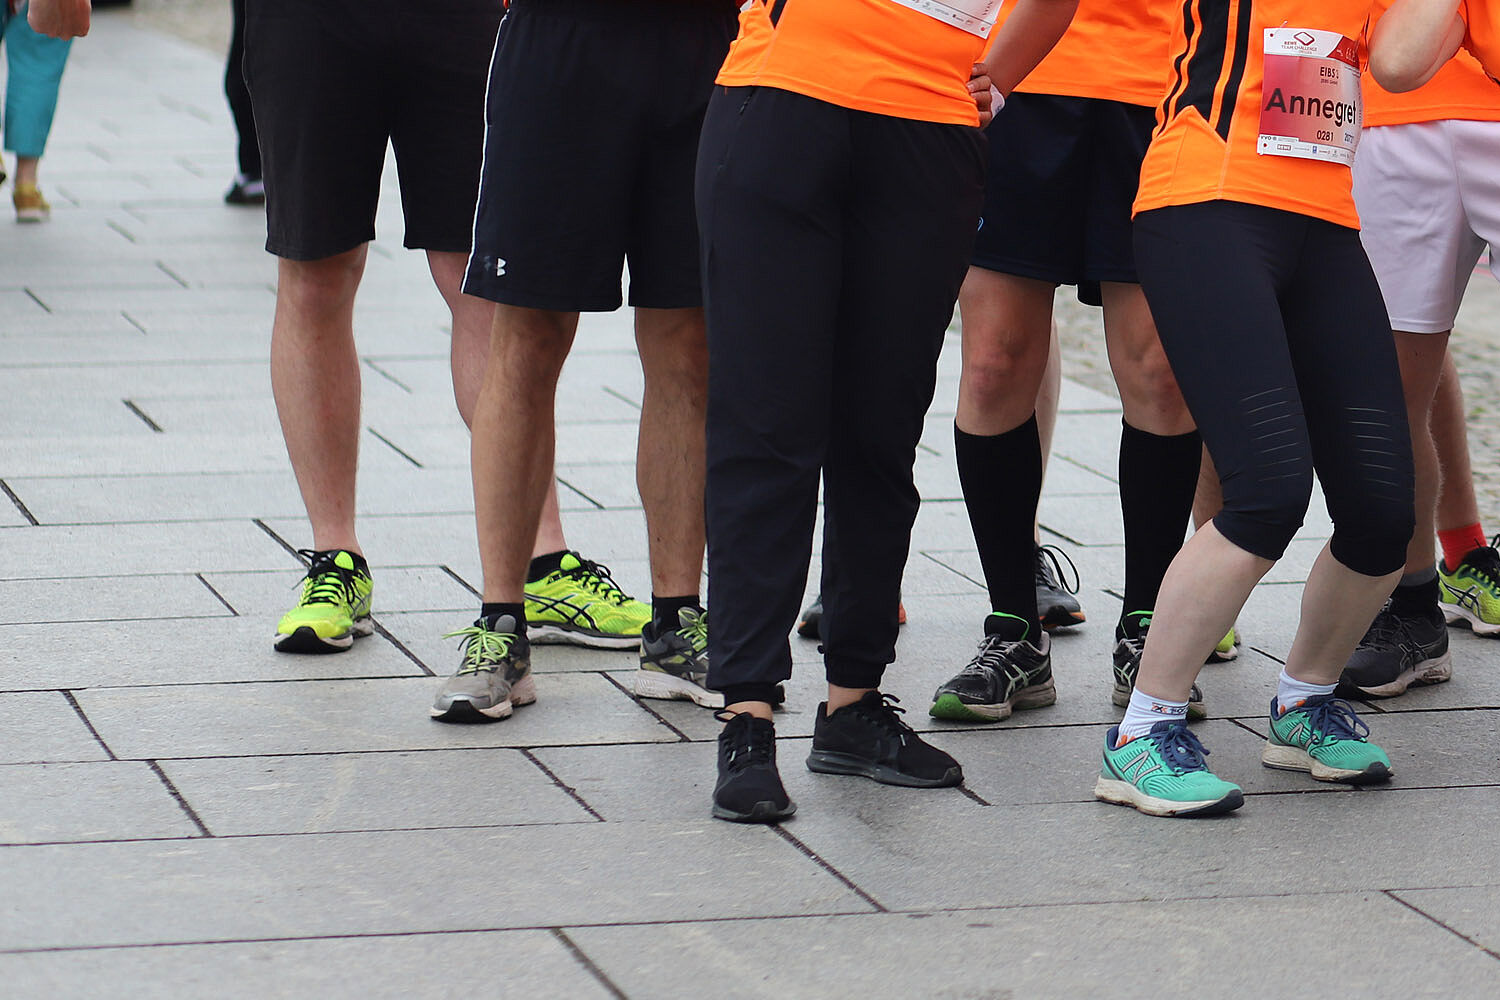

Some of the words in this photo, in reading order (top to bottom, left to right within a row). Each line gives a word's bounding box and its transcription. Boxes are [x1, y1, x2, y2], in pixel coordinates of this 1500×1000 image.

[1320, 66, 1336, 79] EIBS
[1264, 87, 1356, 128] Annegret
[1316, 130, 1334, 141] 0281
